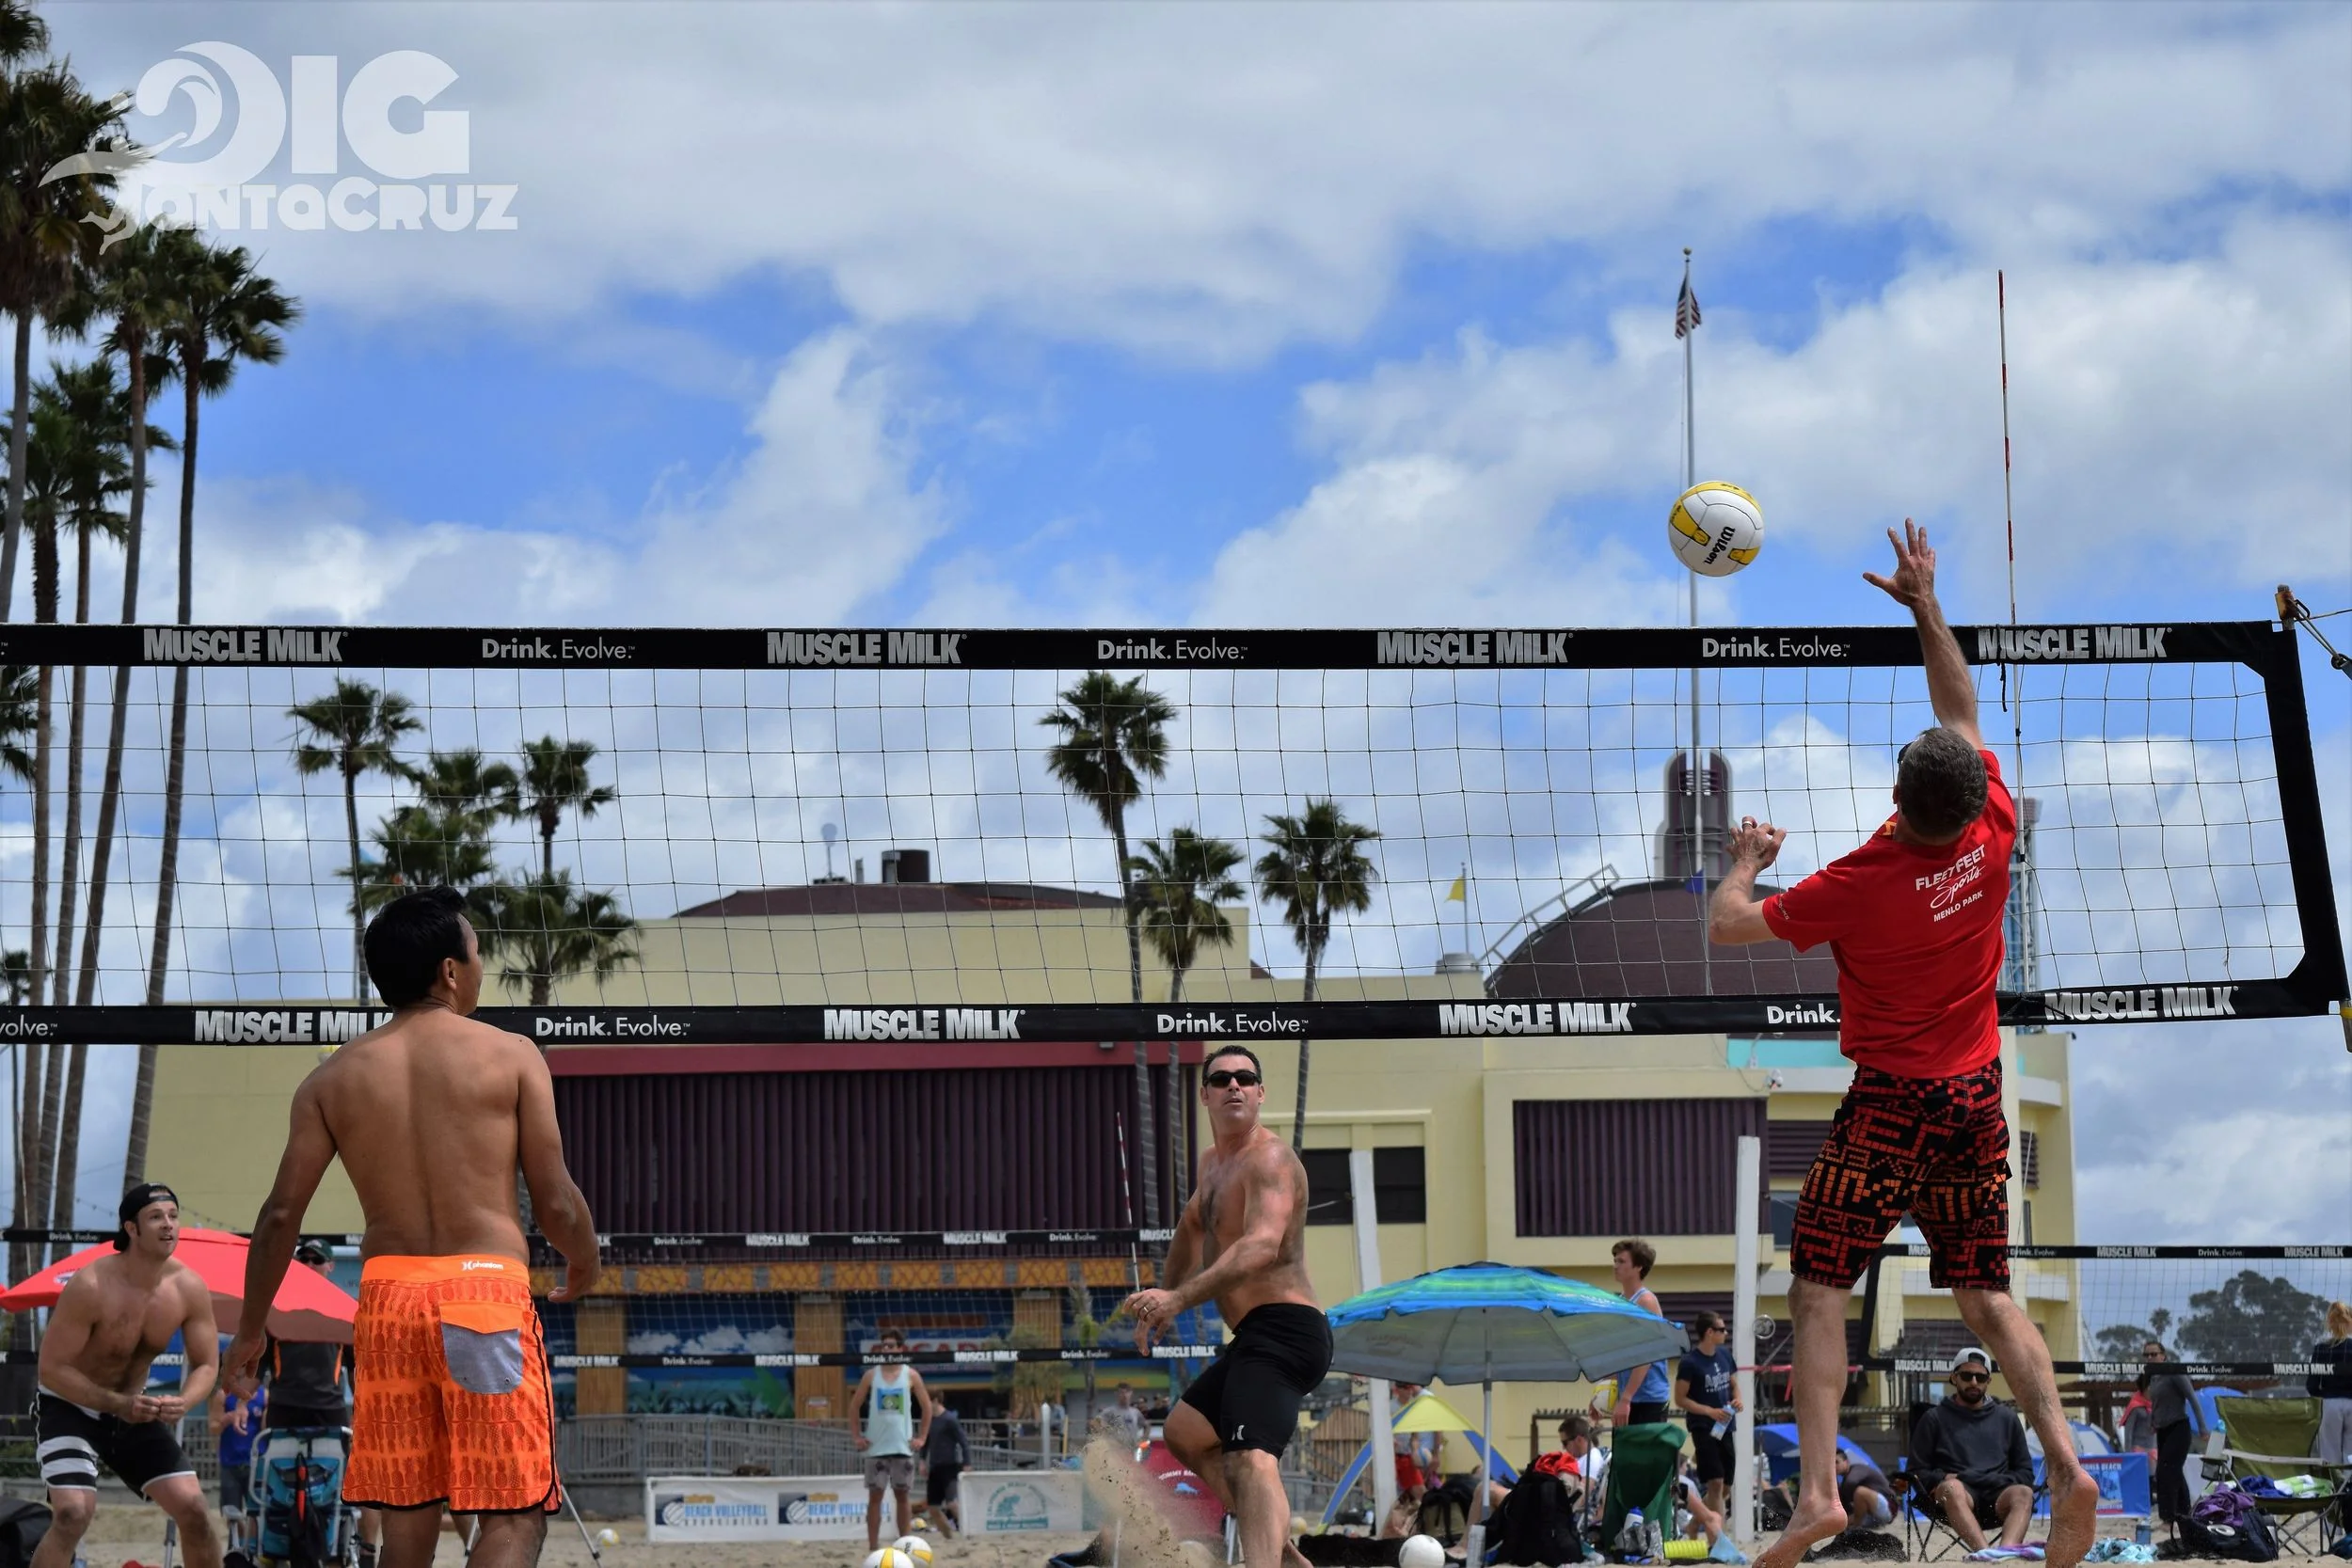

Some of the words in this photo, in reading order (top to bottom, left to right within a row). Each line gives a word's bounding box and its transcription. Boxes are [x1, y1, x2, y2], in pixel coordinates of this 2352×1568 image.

[1704, 526, 1736, 565] Wilson
[143, 629, 262, 662] MUSCLE
[267, 629, 343, 662] MILK
[482, 637, 558, 659] Drink.
[767, 631, 882, 664] MUSCLE
[887, 631, 961, 664] MILK
[1097, 638, 1171, 660] Drink.
[1376, 631, 1490, 664] MUSCLE
[1496, 631, 1568, 663] MILK
[1702, 636, 1775, 658] Drink.
[1978, 626, 2090, 660] MUSCLE
[2094, 626, 2168, 659] MILK
[1915, 865, 1956, 891] FLEET
[1956, 844, 1986, 873] FEET
[1930, 864, 1987, 909] Sports
[1933, 902, 1962, 923] MENLO
[1963, 890, 1984, 908] PARK
[1438, 1003, 1554, 1035] MUSCLE
[1558, 1001, 1634, 1033] MILK
[1767, 1003, 1841, 1024] Drink.
[2044, 989, 2159, 1022] MUSCLE
[2161, 986, 2237, 1018] MILK
[194, 1010, 313, 1043] MUSCLE
[535, 1016, 612, 1037] Drink.
[823, 1008, 940, 1040] MUSCLE
[945, 1008, 1023, 1039] MILK
[1156, 1012, 1232, 1034] Drink.
[2096, 1245, 2133, 1258] MUSCLE
[2134, 1245, 2157, 1258] MILK
[2283, 1246, 2320, 1258] MUSCLE
[2320, 1246, 2344, 1258] MILK
[2084, 1362, 2122, 1374] MUSCLE
[2122, 1363, 2146, 1374] MILK
[2273, 1363, 2310, 1375] MUSCLE
[2311, 1363, 2334, 1375] MILK
